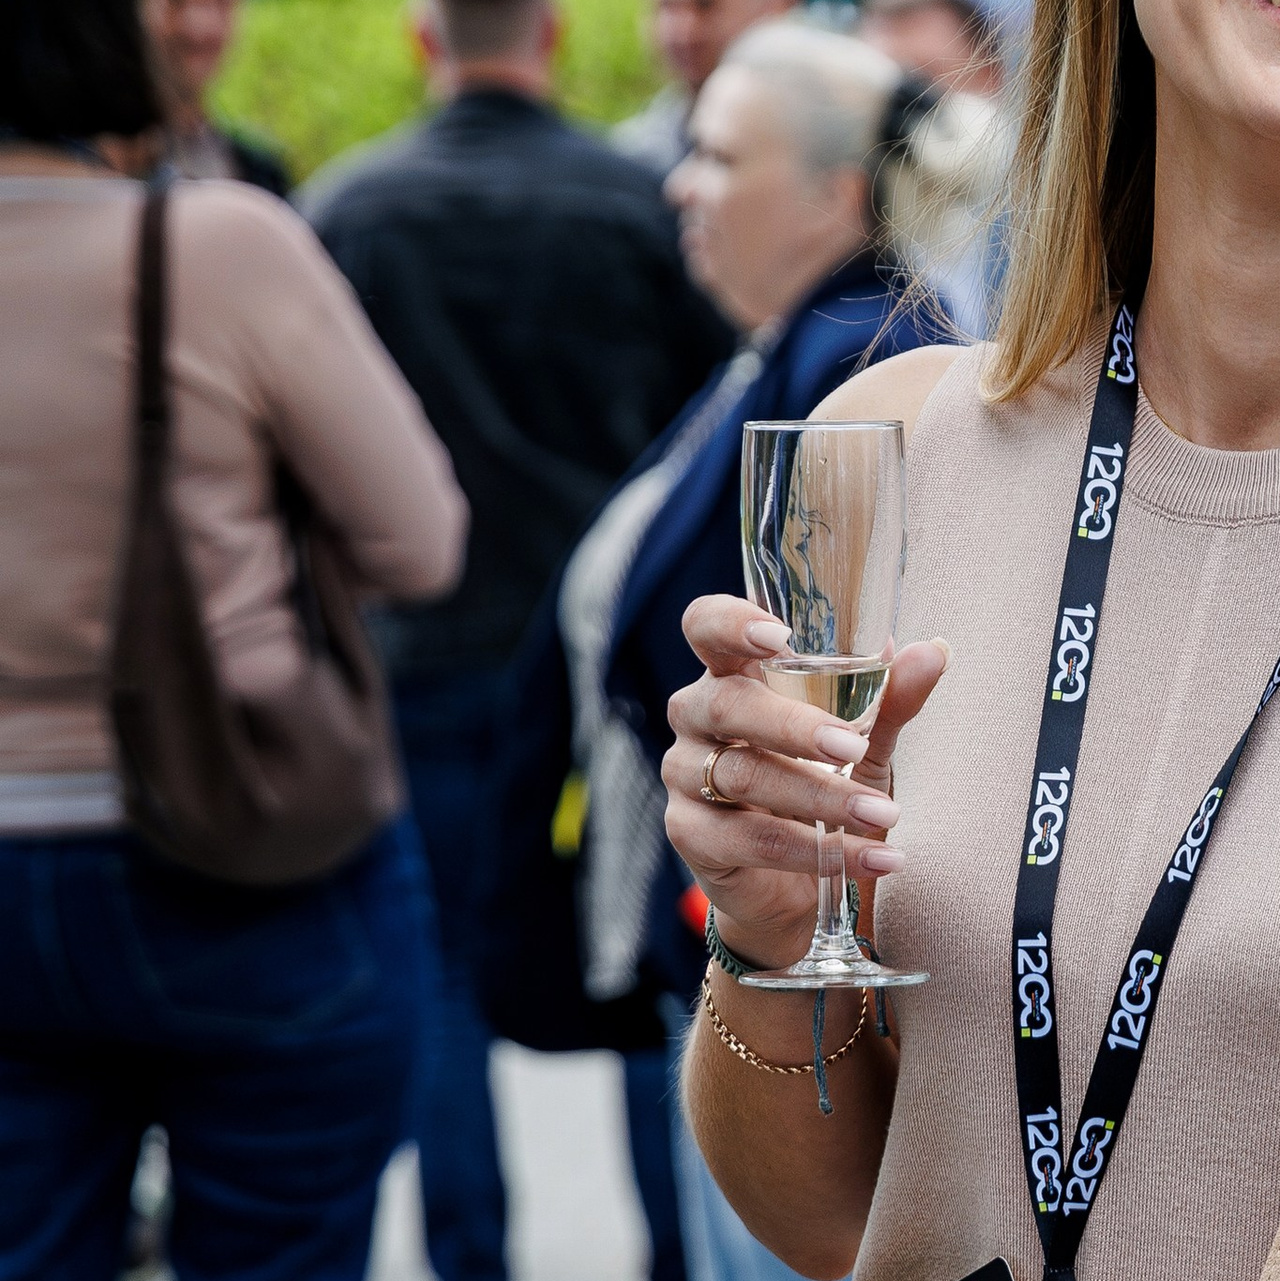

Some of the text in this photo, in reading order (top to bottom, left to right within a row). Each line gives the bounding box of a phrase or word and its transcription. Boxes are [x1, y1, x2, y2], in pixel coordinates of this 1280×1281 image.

[1077, 442, 1124, 540] 1200
[1052, 602, 1096, 702] 1200
[1027, 767, 1070, 865] 1200
[1167, 786, 1223, 883] 1200
[1017, 931, 1052, 1038] 1200
[1107, 949, 1162, 1051] 1200
[1026, 1106, 1063, 1212] 1200
[1062, 1117, 1115, 1216] 1200
